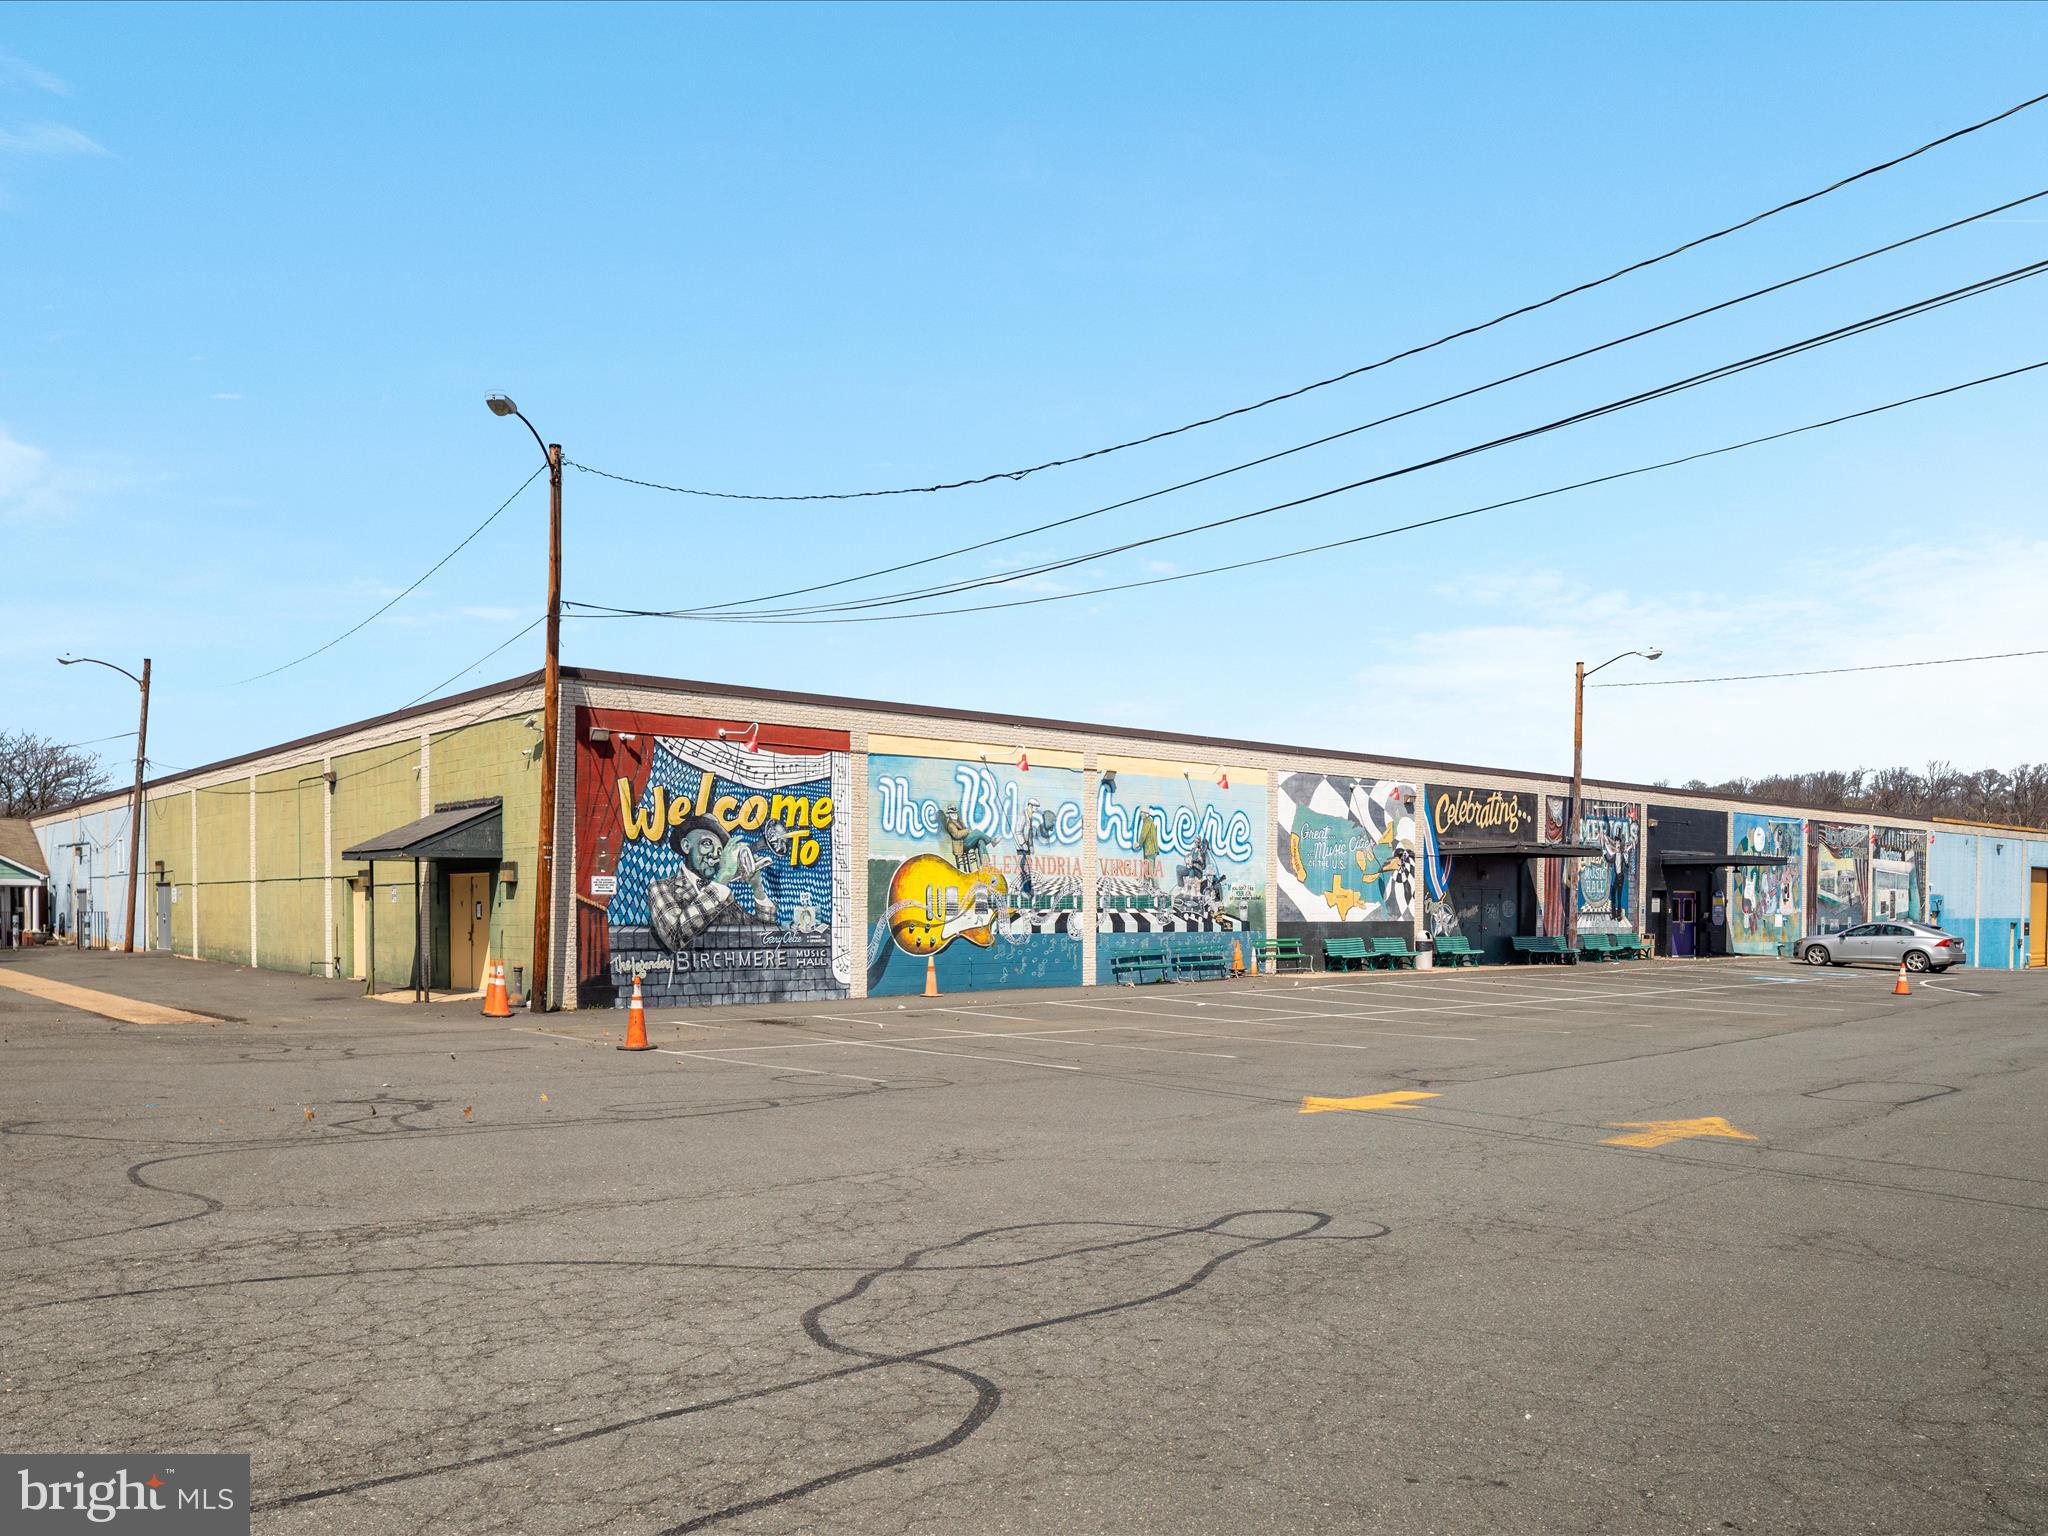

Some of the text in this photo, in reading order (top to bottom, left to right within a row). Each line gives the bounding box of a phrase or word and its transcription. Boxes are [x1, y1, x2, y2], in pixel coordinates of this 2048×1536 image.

[617, 772, 833, 842] Welcome
[878, 774, 939, 838] The
[784, 830, 820, 866] To
[980, 854, 1164, 879] ALEXANDRIA VIRGINIA
[1319, 860, 1329, 868] THE
[1584, 867, 1607, 880] MUSIC
[1585, 880, 1606, 893] HALL
[760, 931, 783, 952] Gary
[610, 954, 632, 974] The
[676, 951, 787, 971] BIRCHMERE
[796, 949, 827, 957] MUSIC
[796, 957, 827, 966] HALL
